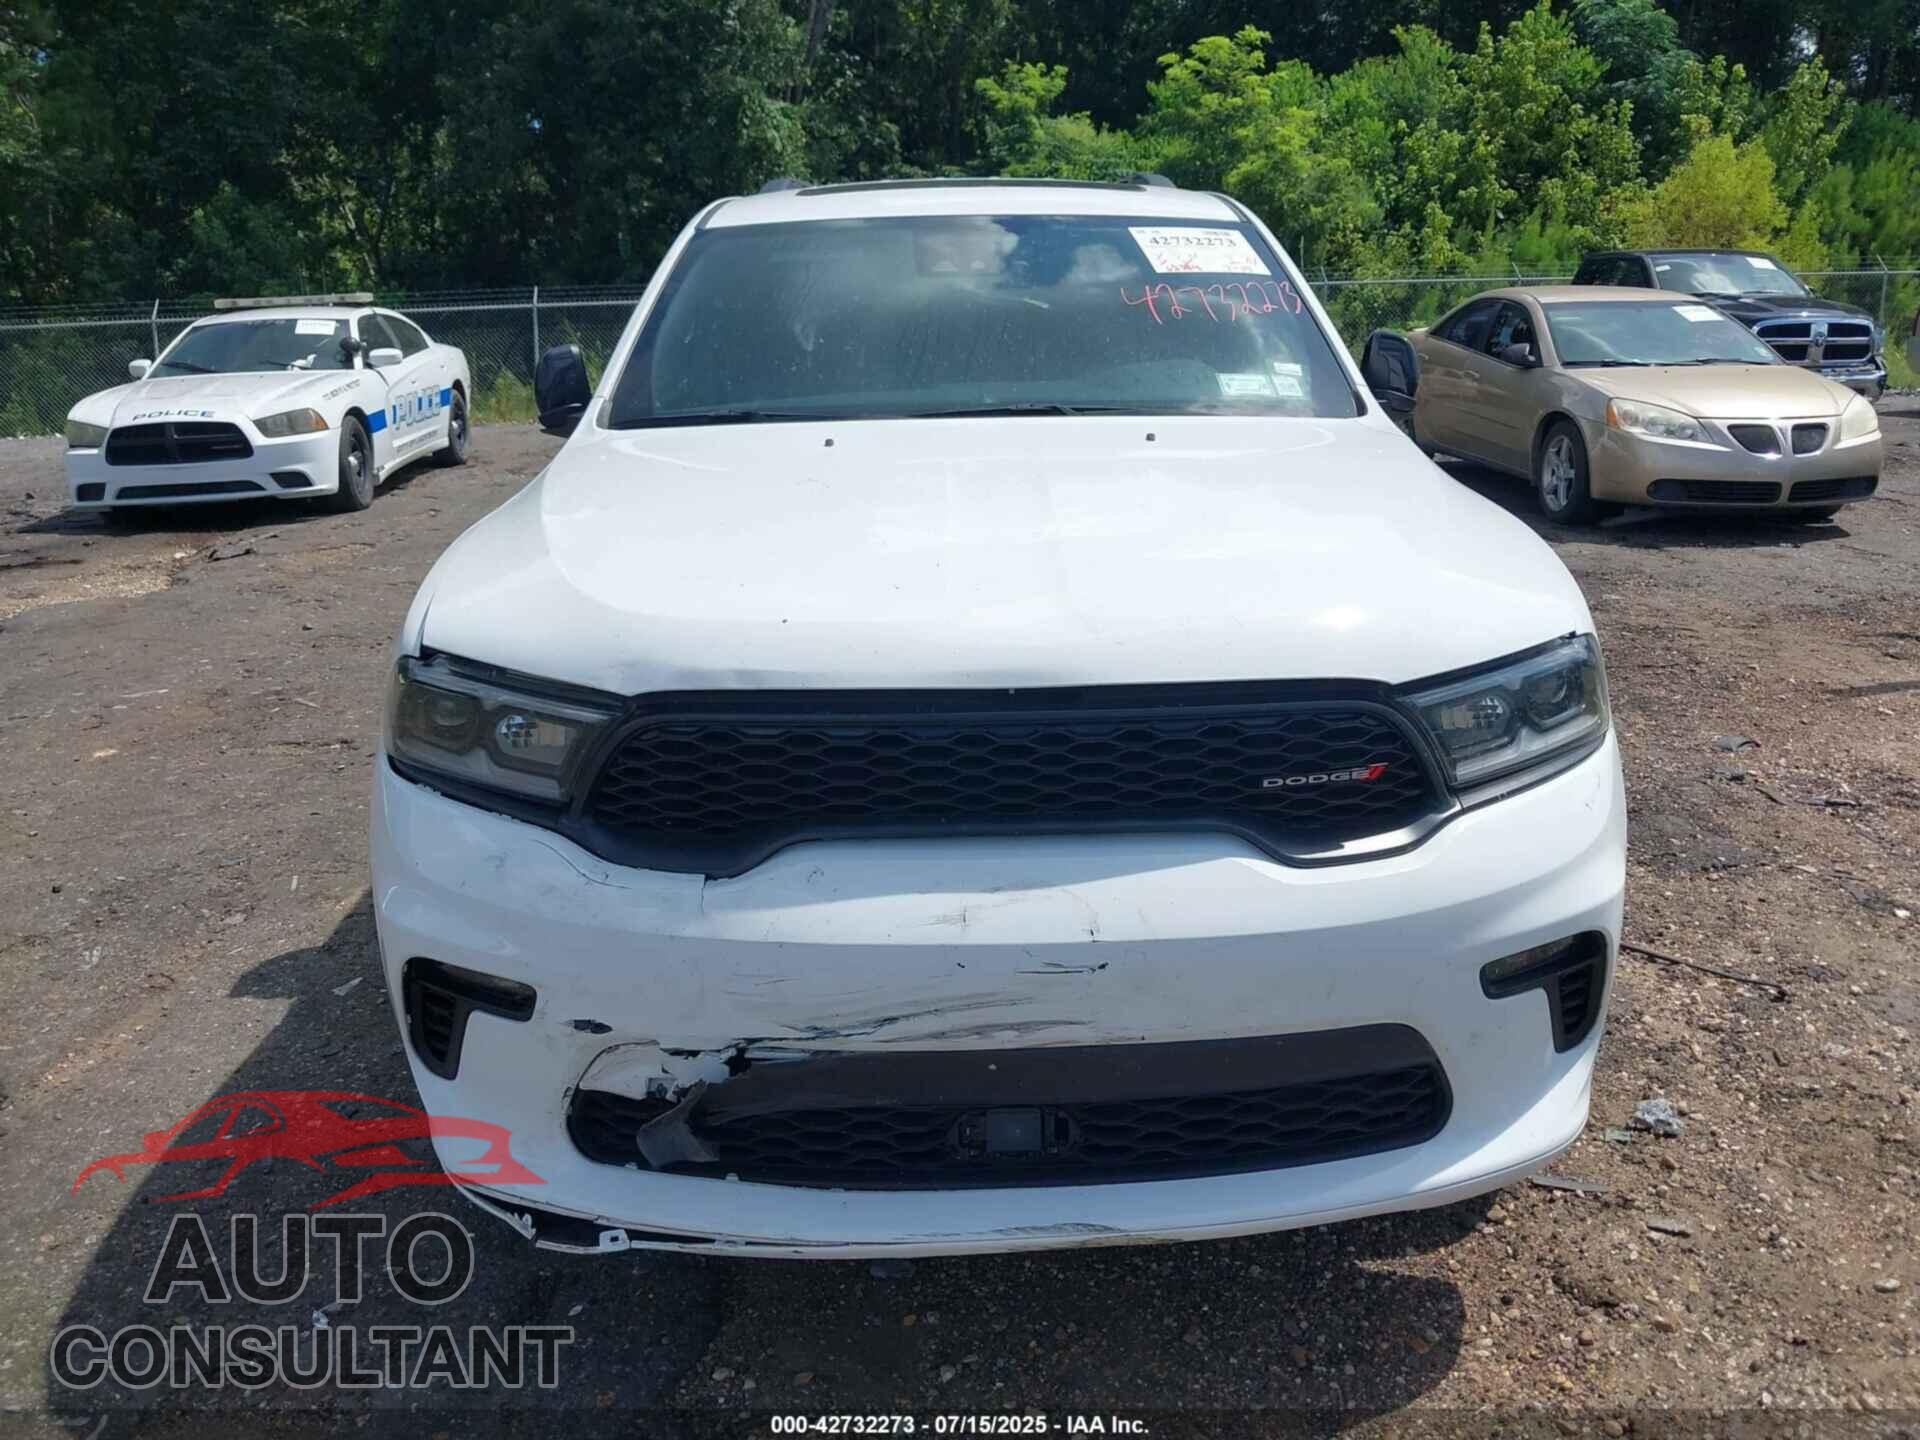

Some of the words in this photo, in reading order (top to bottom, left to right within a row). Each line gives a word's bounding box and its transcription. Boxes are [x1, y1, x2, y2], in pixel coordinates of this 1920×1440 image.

[1149, 235, 1237, 248] 42732273
[132, 409, 216, 421] POLICE
[391, 384, 441, 431] POLICE
[1262, 767, 1370, 788] DODGE
